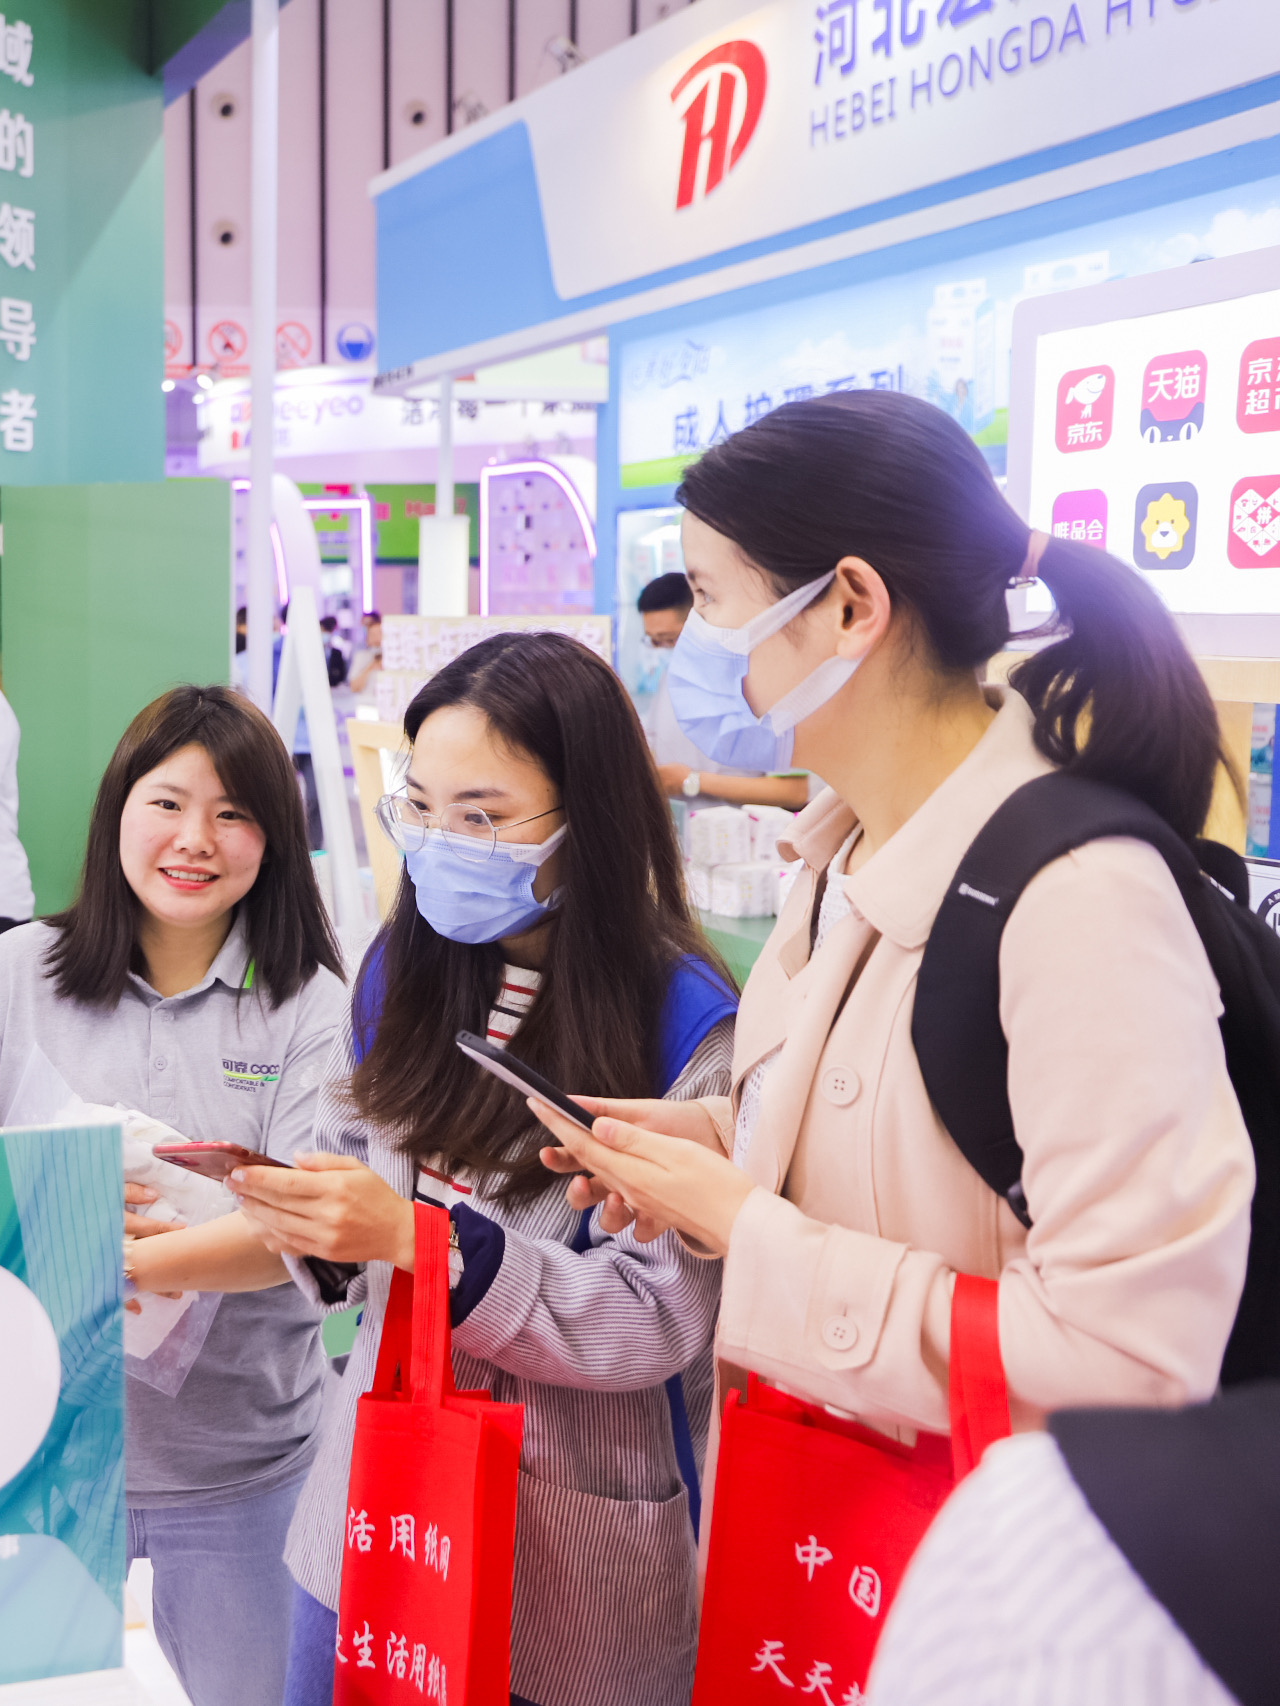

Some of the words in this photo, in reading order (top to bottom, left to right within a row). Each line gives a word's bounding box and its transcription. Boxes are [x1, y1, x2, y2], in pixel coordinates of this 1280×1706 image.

[808, 76, 898, 148] HEBEI
[909, 2, 1087, 111] HONGDA
[1147, 364, 1202, 403] 天猫
[1066, 421, 1104, 446] 京东
[1054, 518, 1104, 541] 唯品会
[794, 1534, 882, 1618] 中国
